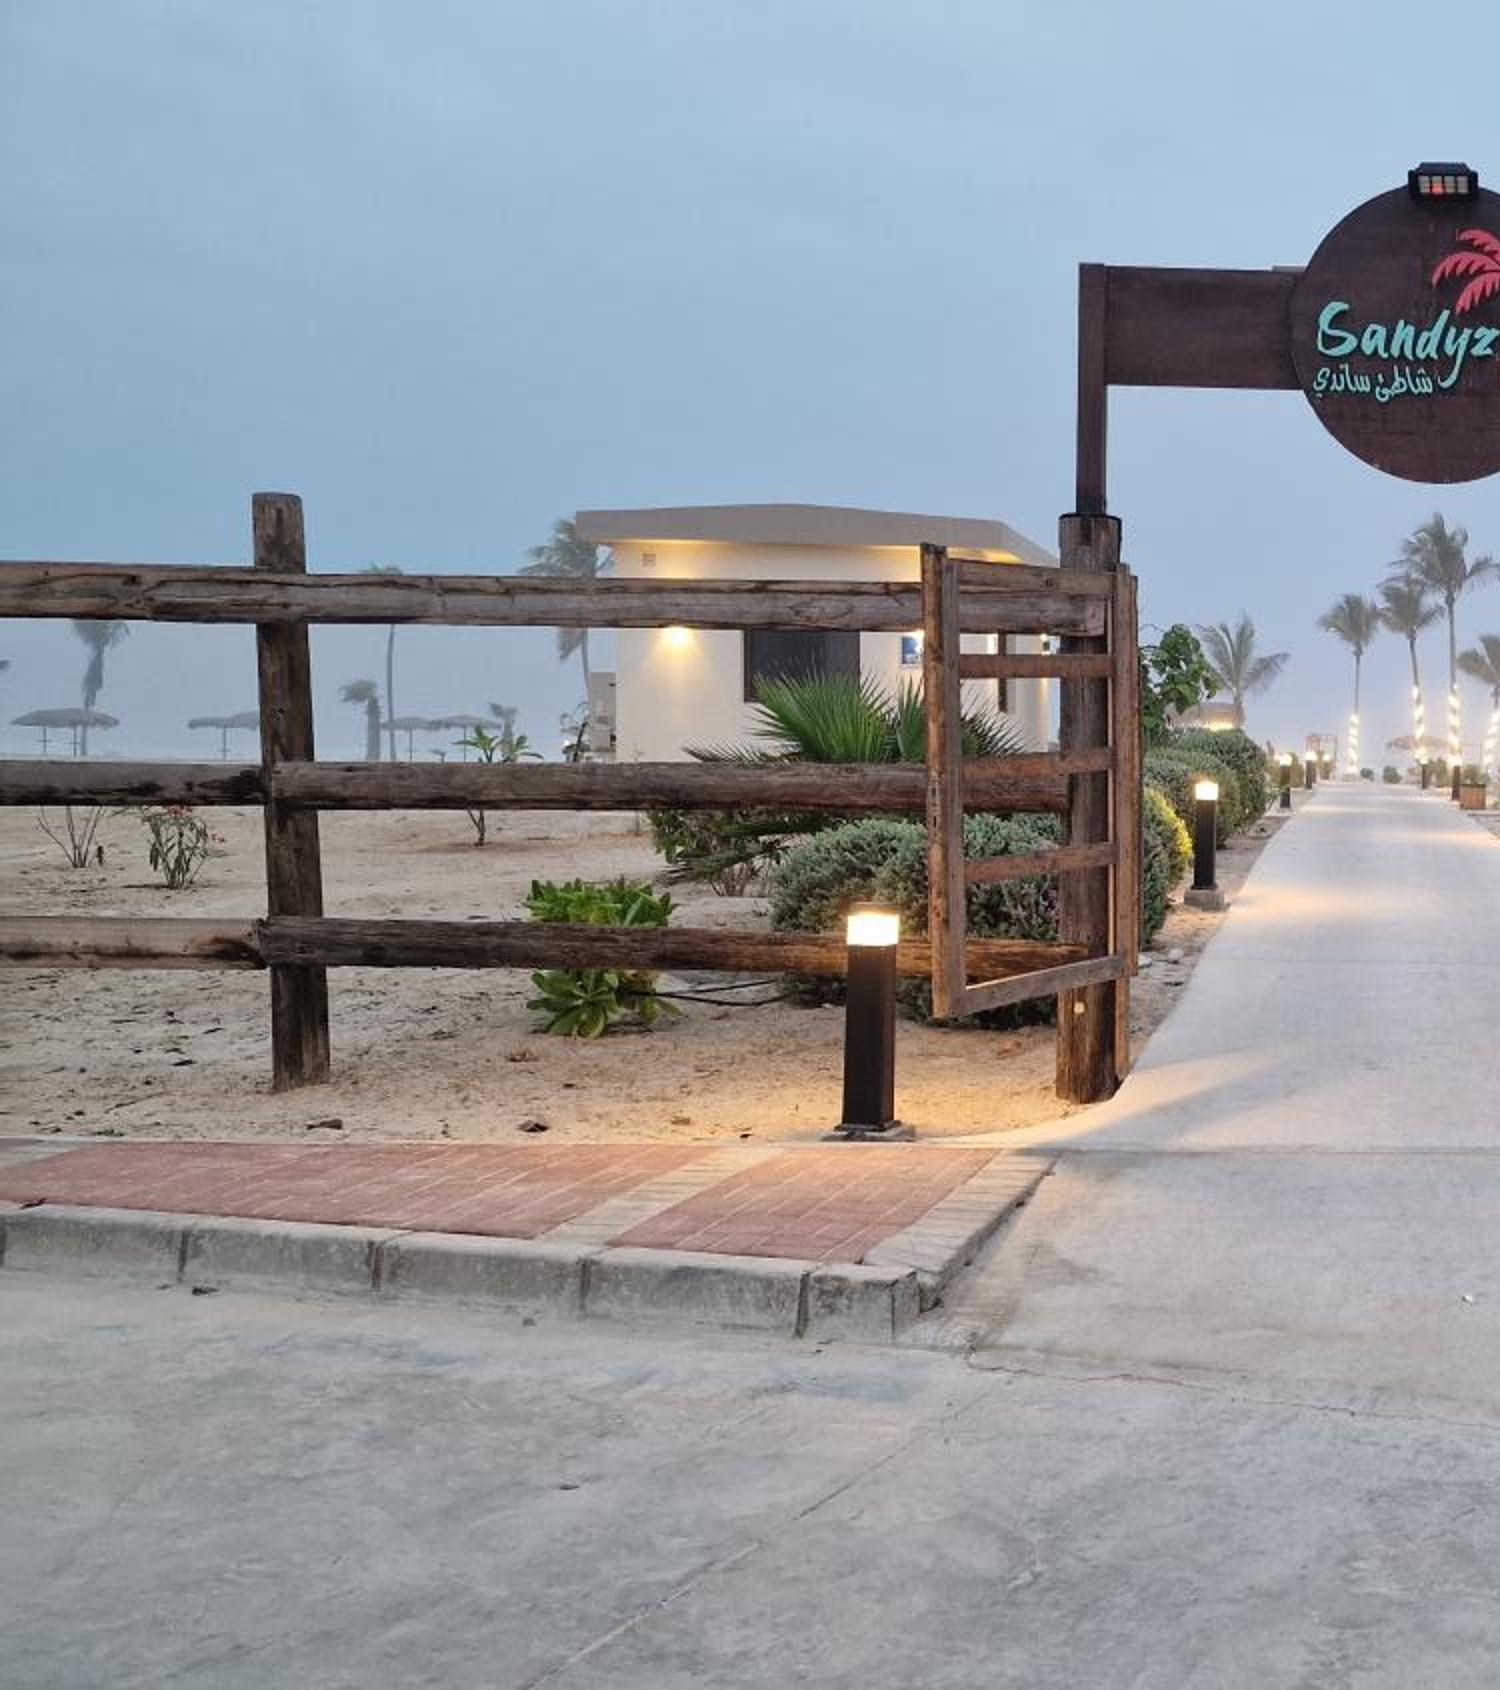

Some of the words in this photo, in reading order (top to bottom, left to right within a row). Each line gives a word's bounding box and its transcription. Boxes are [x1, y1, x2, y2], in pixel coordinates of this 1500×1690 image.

[1317, 301, 1500, 389] Sandyz
[1313, 362, 1371, 398] ساندي
[1375, 364, 1433, 402] شاطئ
